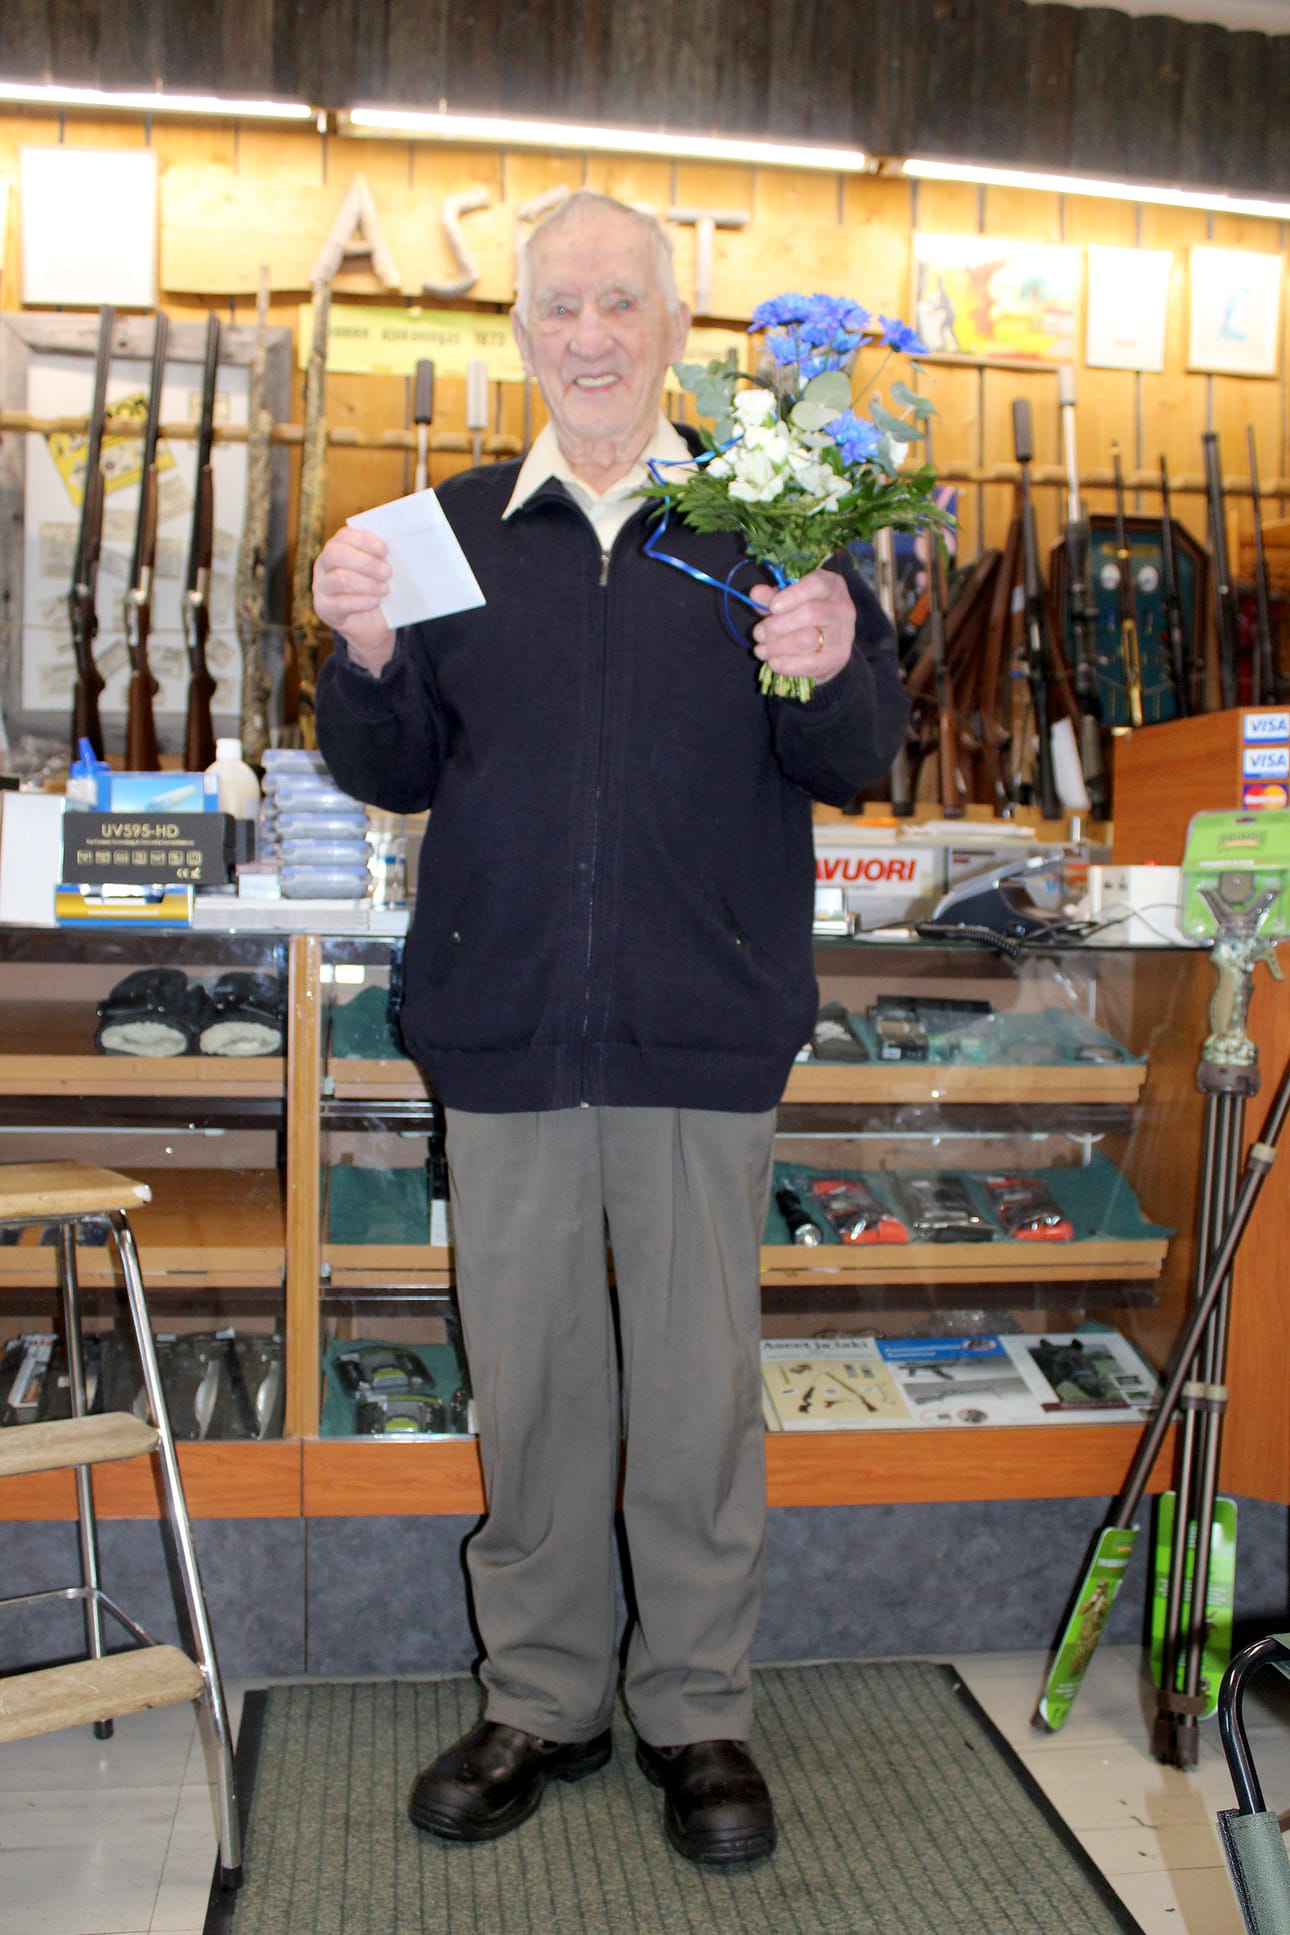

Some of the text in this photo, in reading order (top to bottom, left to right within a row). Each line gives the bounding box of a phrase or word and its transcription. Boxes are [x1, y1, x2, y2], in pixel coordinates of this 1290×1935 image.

[1250, 718, 1287, 732] VISA
[1249, 753, 1287, 768] VISA
[101, 823, 179, 838] UV595-HD
